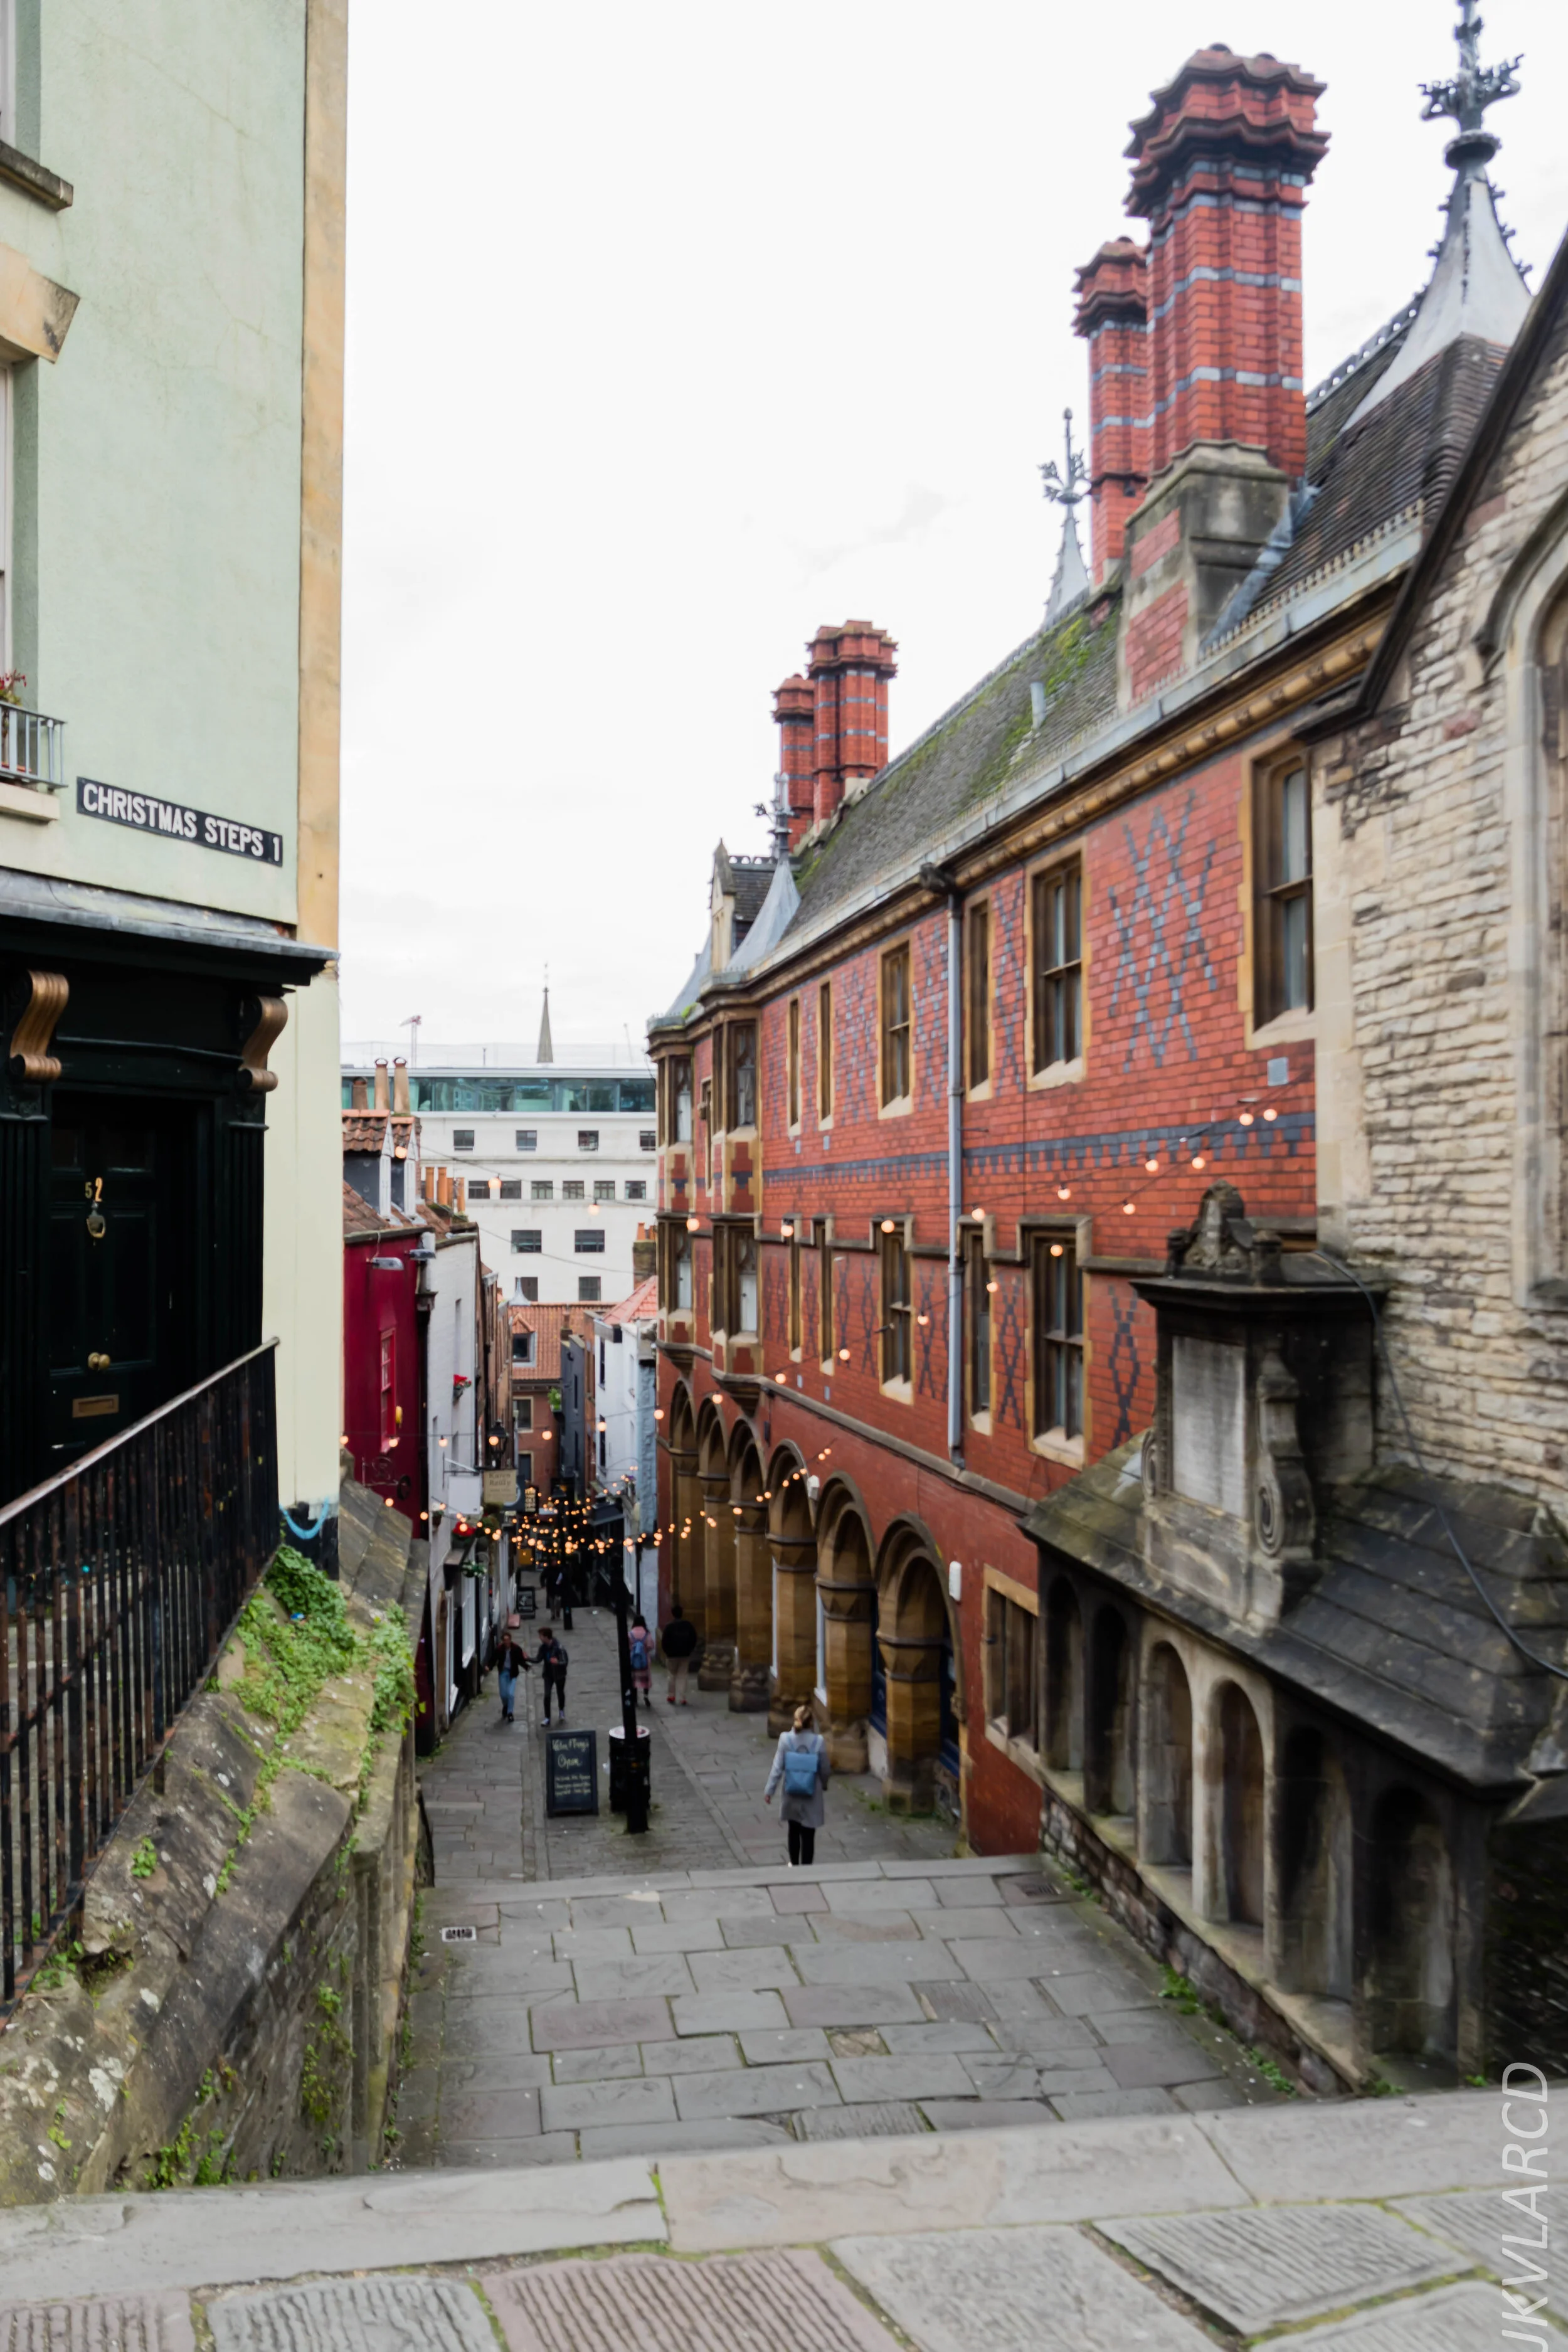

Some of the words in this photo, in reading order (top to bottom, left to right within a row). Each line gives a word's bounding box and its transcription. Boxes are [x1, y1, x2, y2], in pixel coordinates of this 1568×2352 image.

[83, 783, 198, 839] CHRISTMAS
[204, 817, 264, 857] STEPS
[272, 836, 280, 862] 1
[85, 1177, 103, 1202] 52
